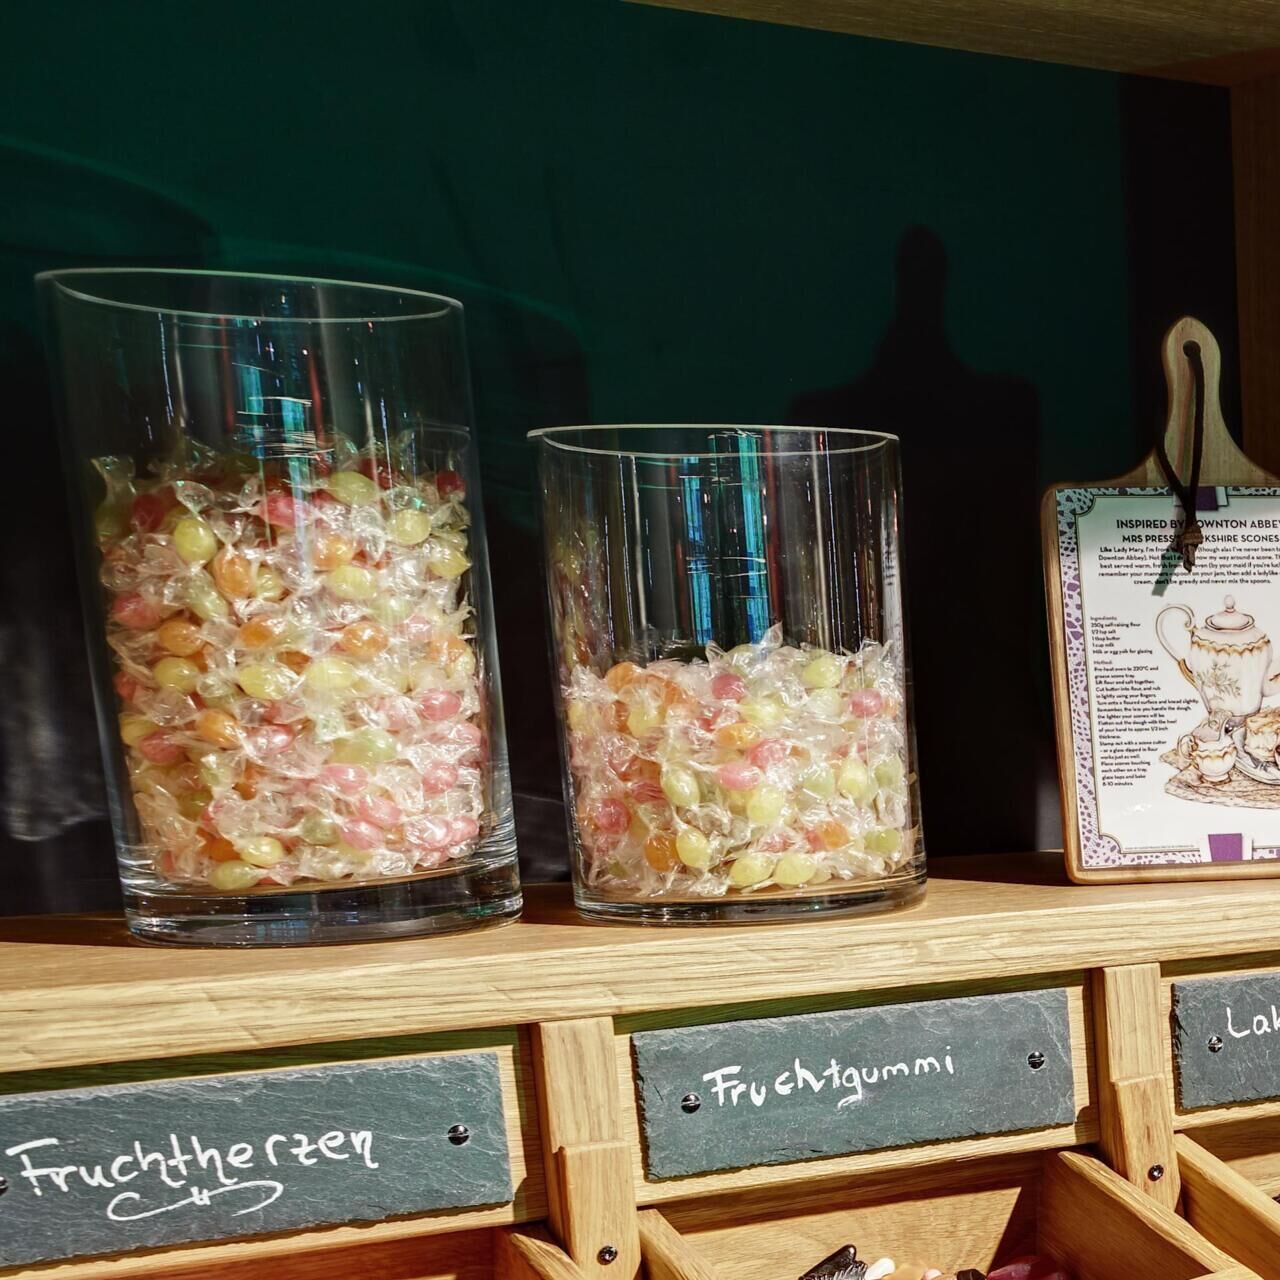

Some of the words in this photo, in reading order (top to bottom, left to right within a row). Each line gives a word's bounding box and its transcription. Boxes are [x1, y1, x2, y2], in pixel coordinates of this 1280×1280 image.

[1116, 519, 1167, 528] INSPIRED
[1170, 519, 1185, 528] BY
[1196, 518, 1247, 528] OWNTON
[1122, 534, 1142, 543] MRS
[1241, 533, 1280, 542] SCONES
[703, 1045, 956, 1110] Fruchtgummi
[5, 1129, 381, 1197] Fruchtherzen
